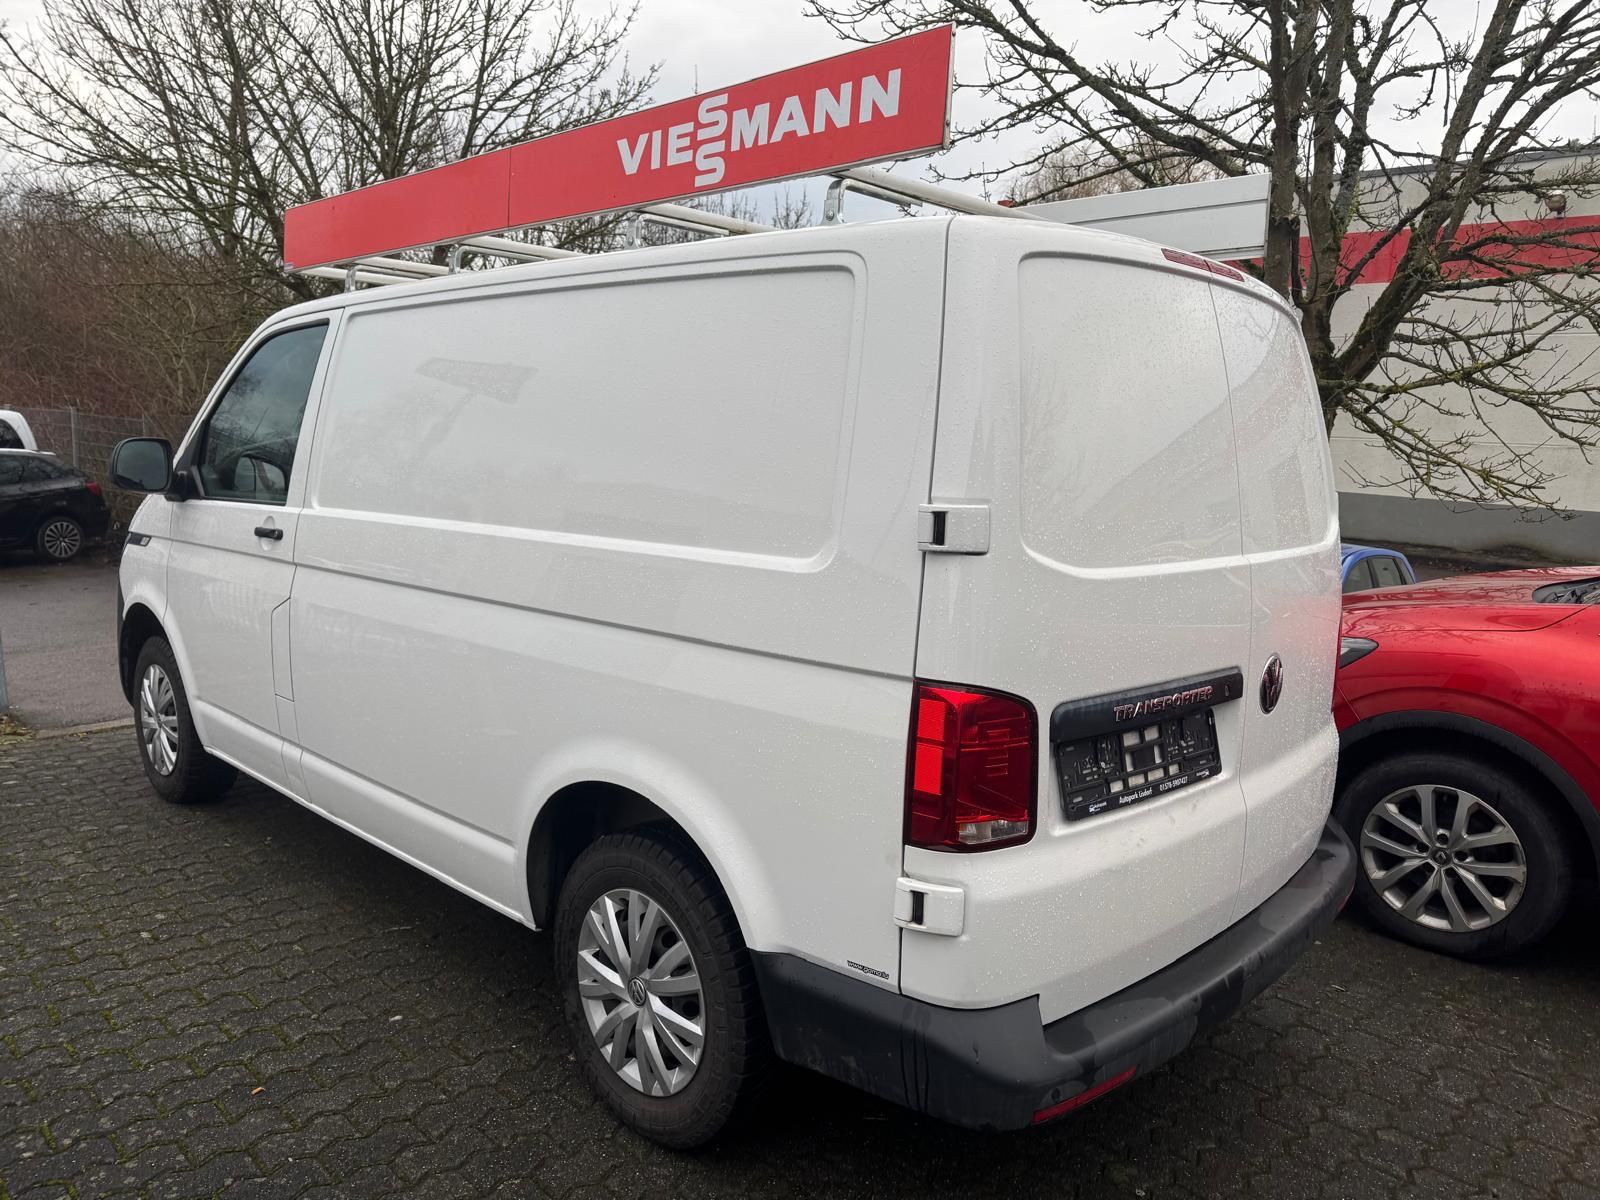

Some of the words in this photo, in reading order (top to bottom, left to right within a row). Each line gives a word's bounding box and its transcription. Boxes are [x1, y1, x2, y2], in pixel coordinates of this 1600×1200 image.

[617, 68, 901, 187] VIESSMANN
[1114, 685, 1213, 722] TRANSPORTER
[1119, 791, 1138, 803] Autopark
